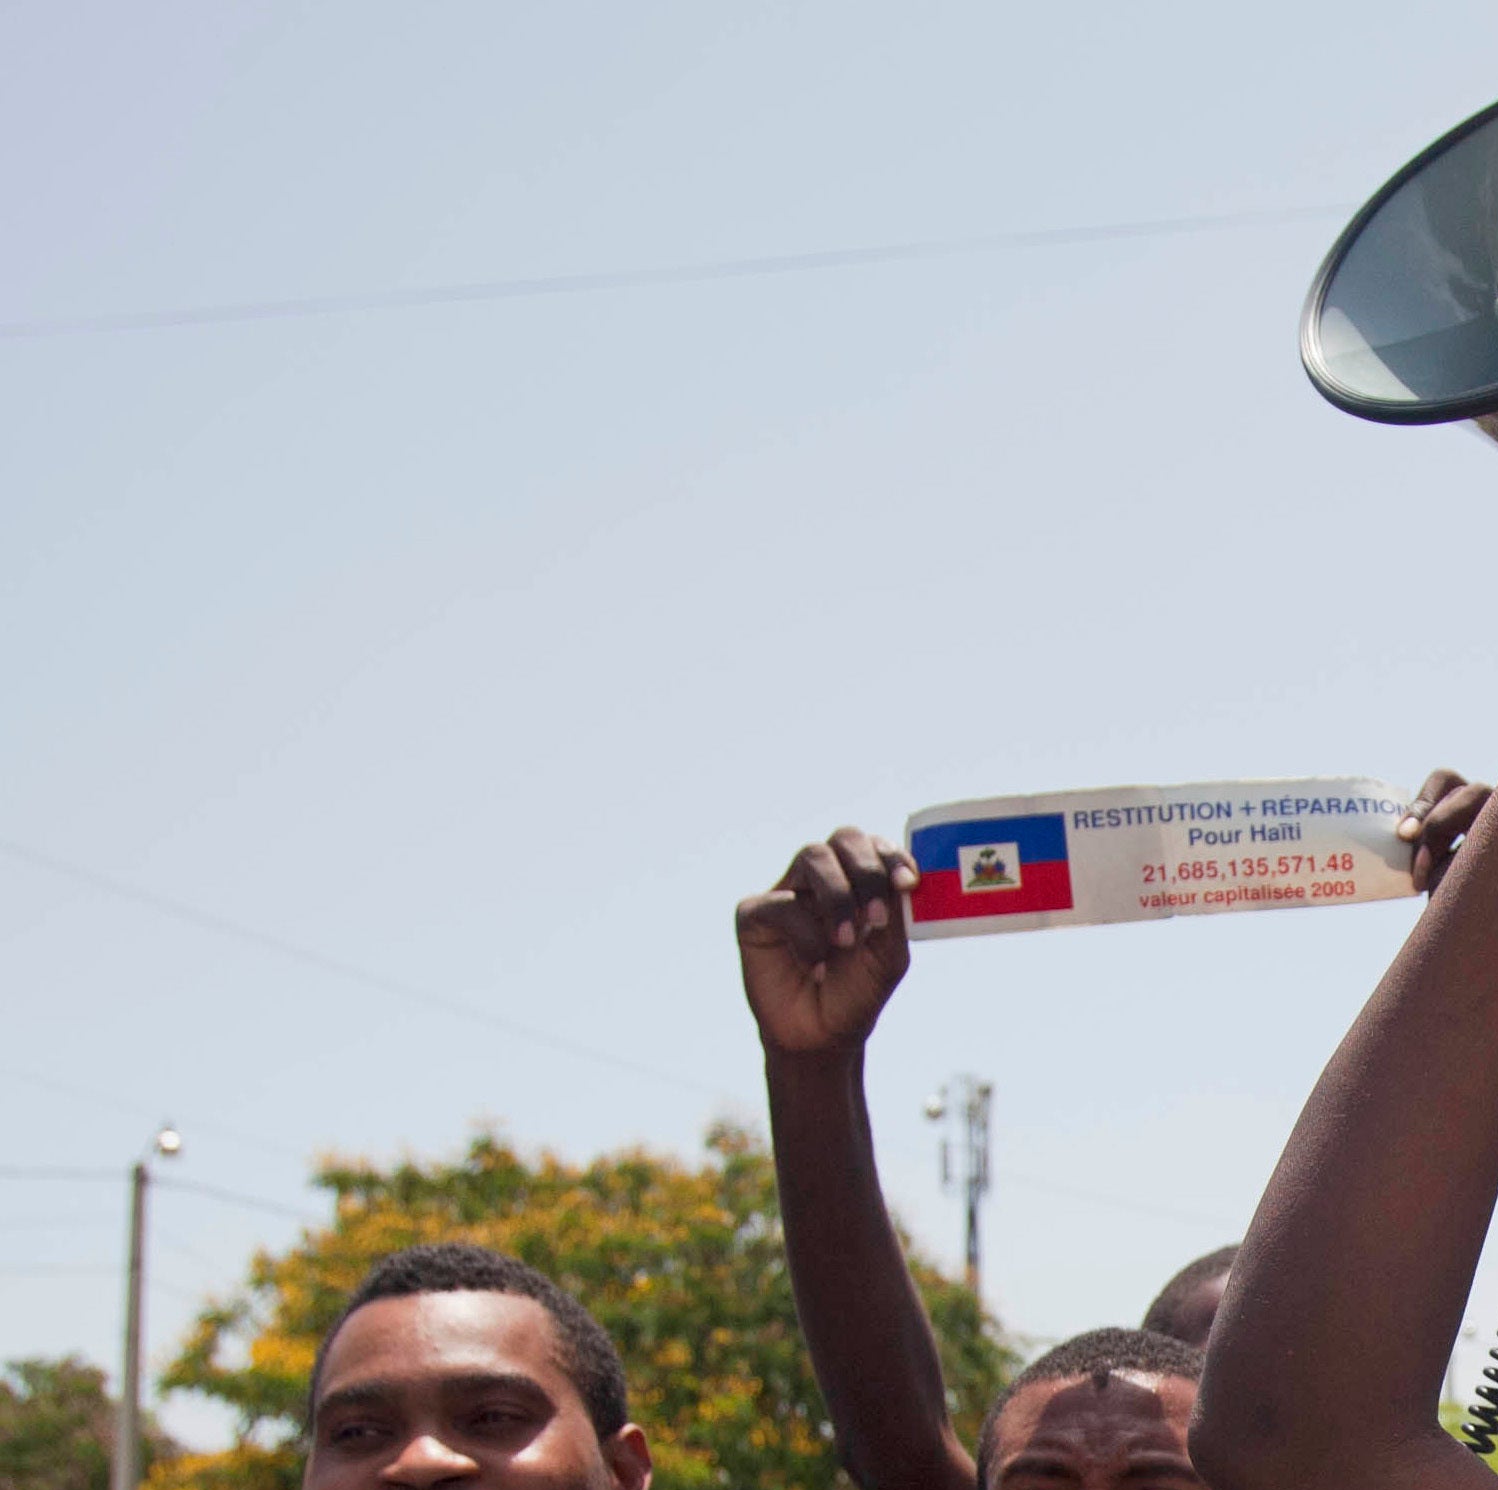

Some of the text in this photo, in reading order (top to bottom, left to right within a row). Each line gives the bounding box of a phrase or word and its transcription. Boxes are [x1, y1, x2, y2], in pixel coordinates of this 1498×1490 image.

[1073, 801, 1232, 829] RESTITUTION
[1188, 822, 1302, 846] Pour Haïti
[1141, 853, 1355, 885] 21,685,135,571.48
[1139, 880, 1356, 908] valeur capitalisée 2003
